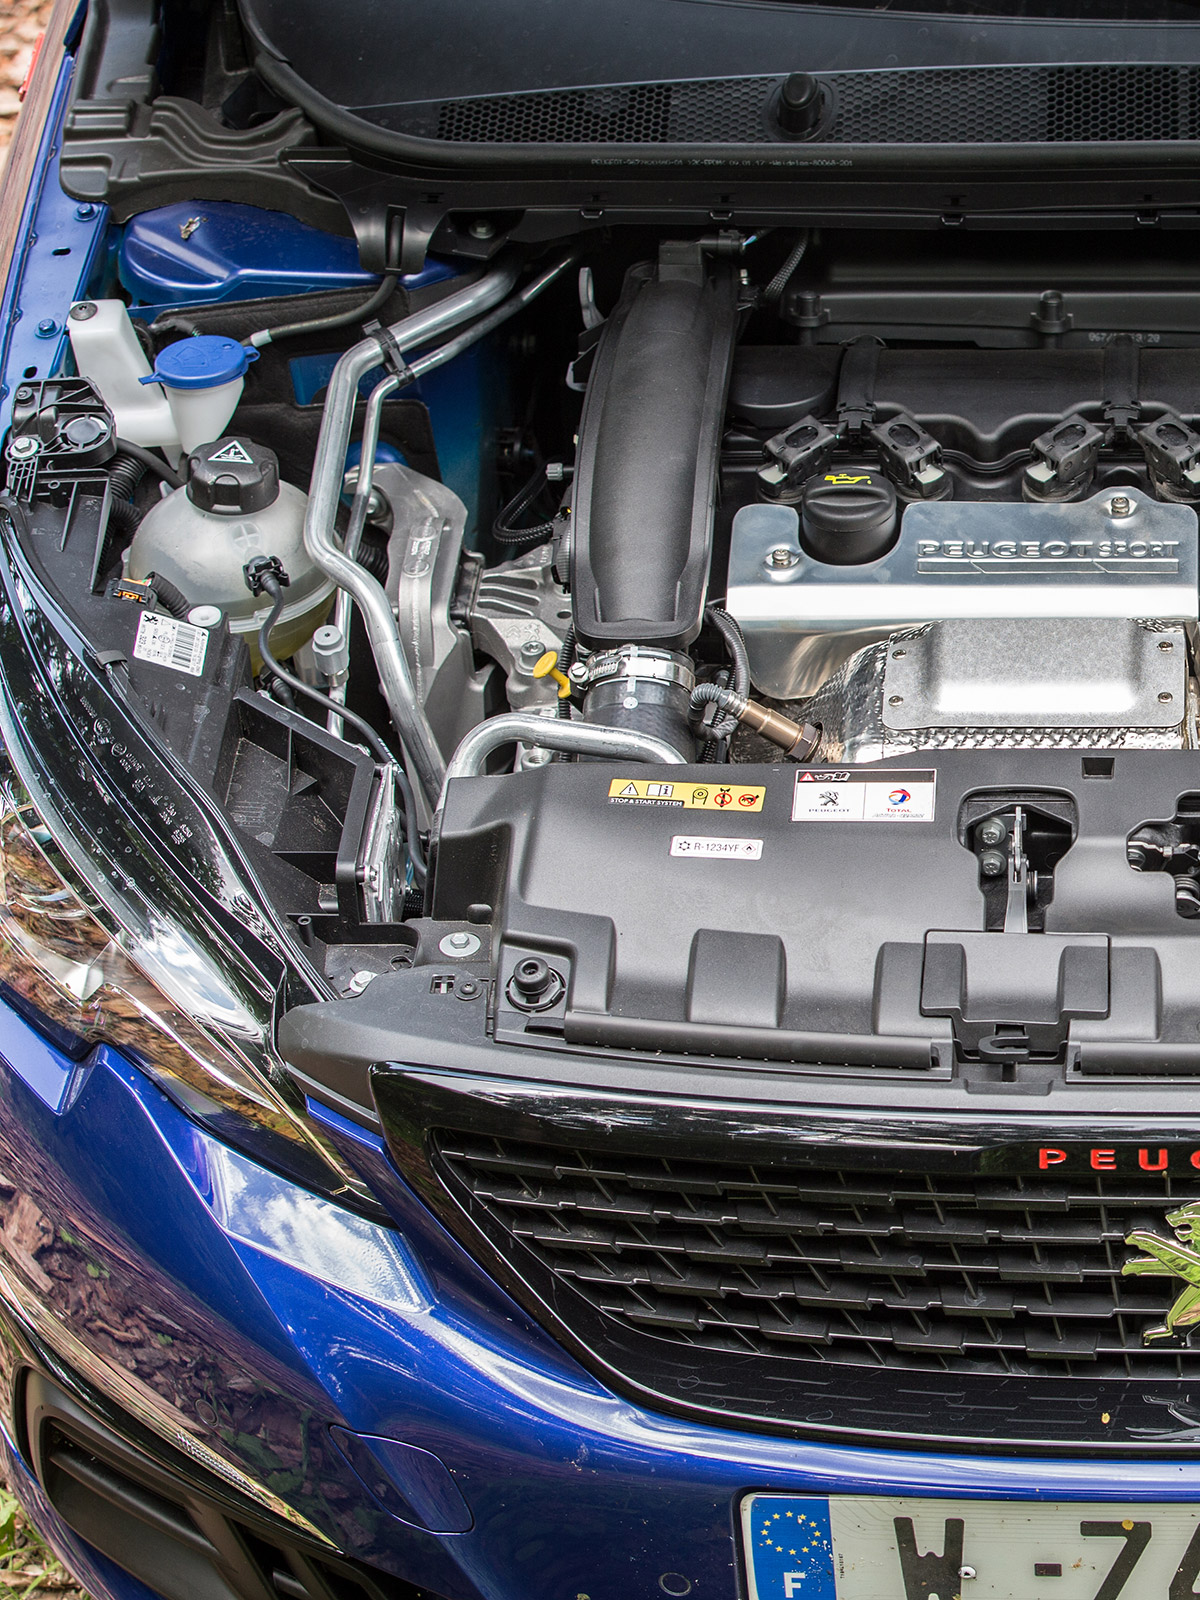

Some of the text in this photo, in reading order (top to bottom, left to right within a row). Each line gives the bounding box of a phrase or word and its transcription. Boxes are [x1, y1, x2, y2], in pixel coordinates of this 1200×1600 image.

[917, 540, 1179, 558] PEUGEOT SPORT
[693, 842, 740, 853] R-1234YF
[783, 1572, 806, 1598] F
